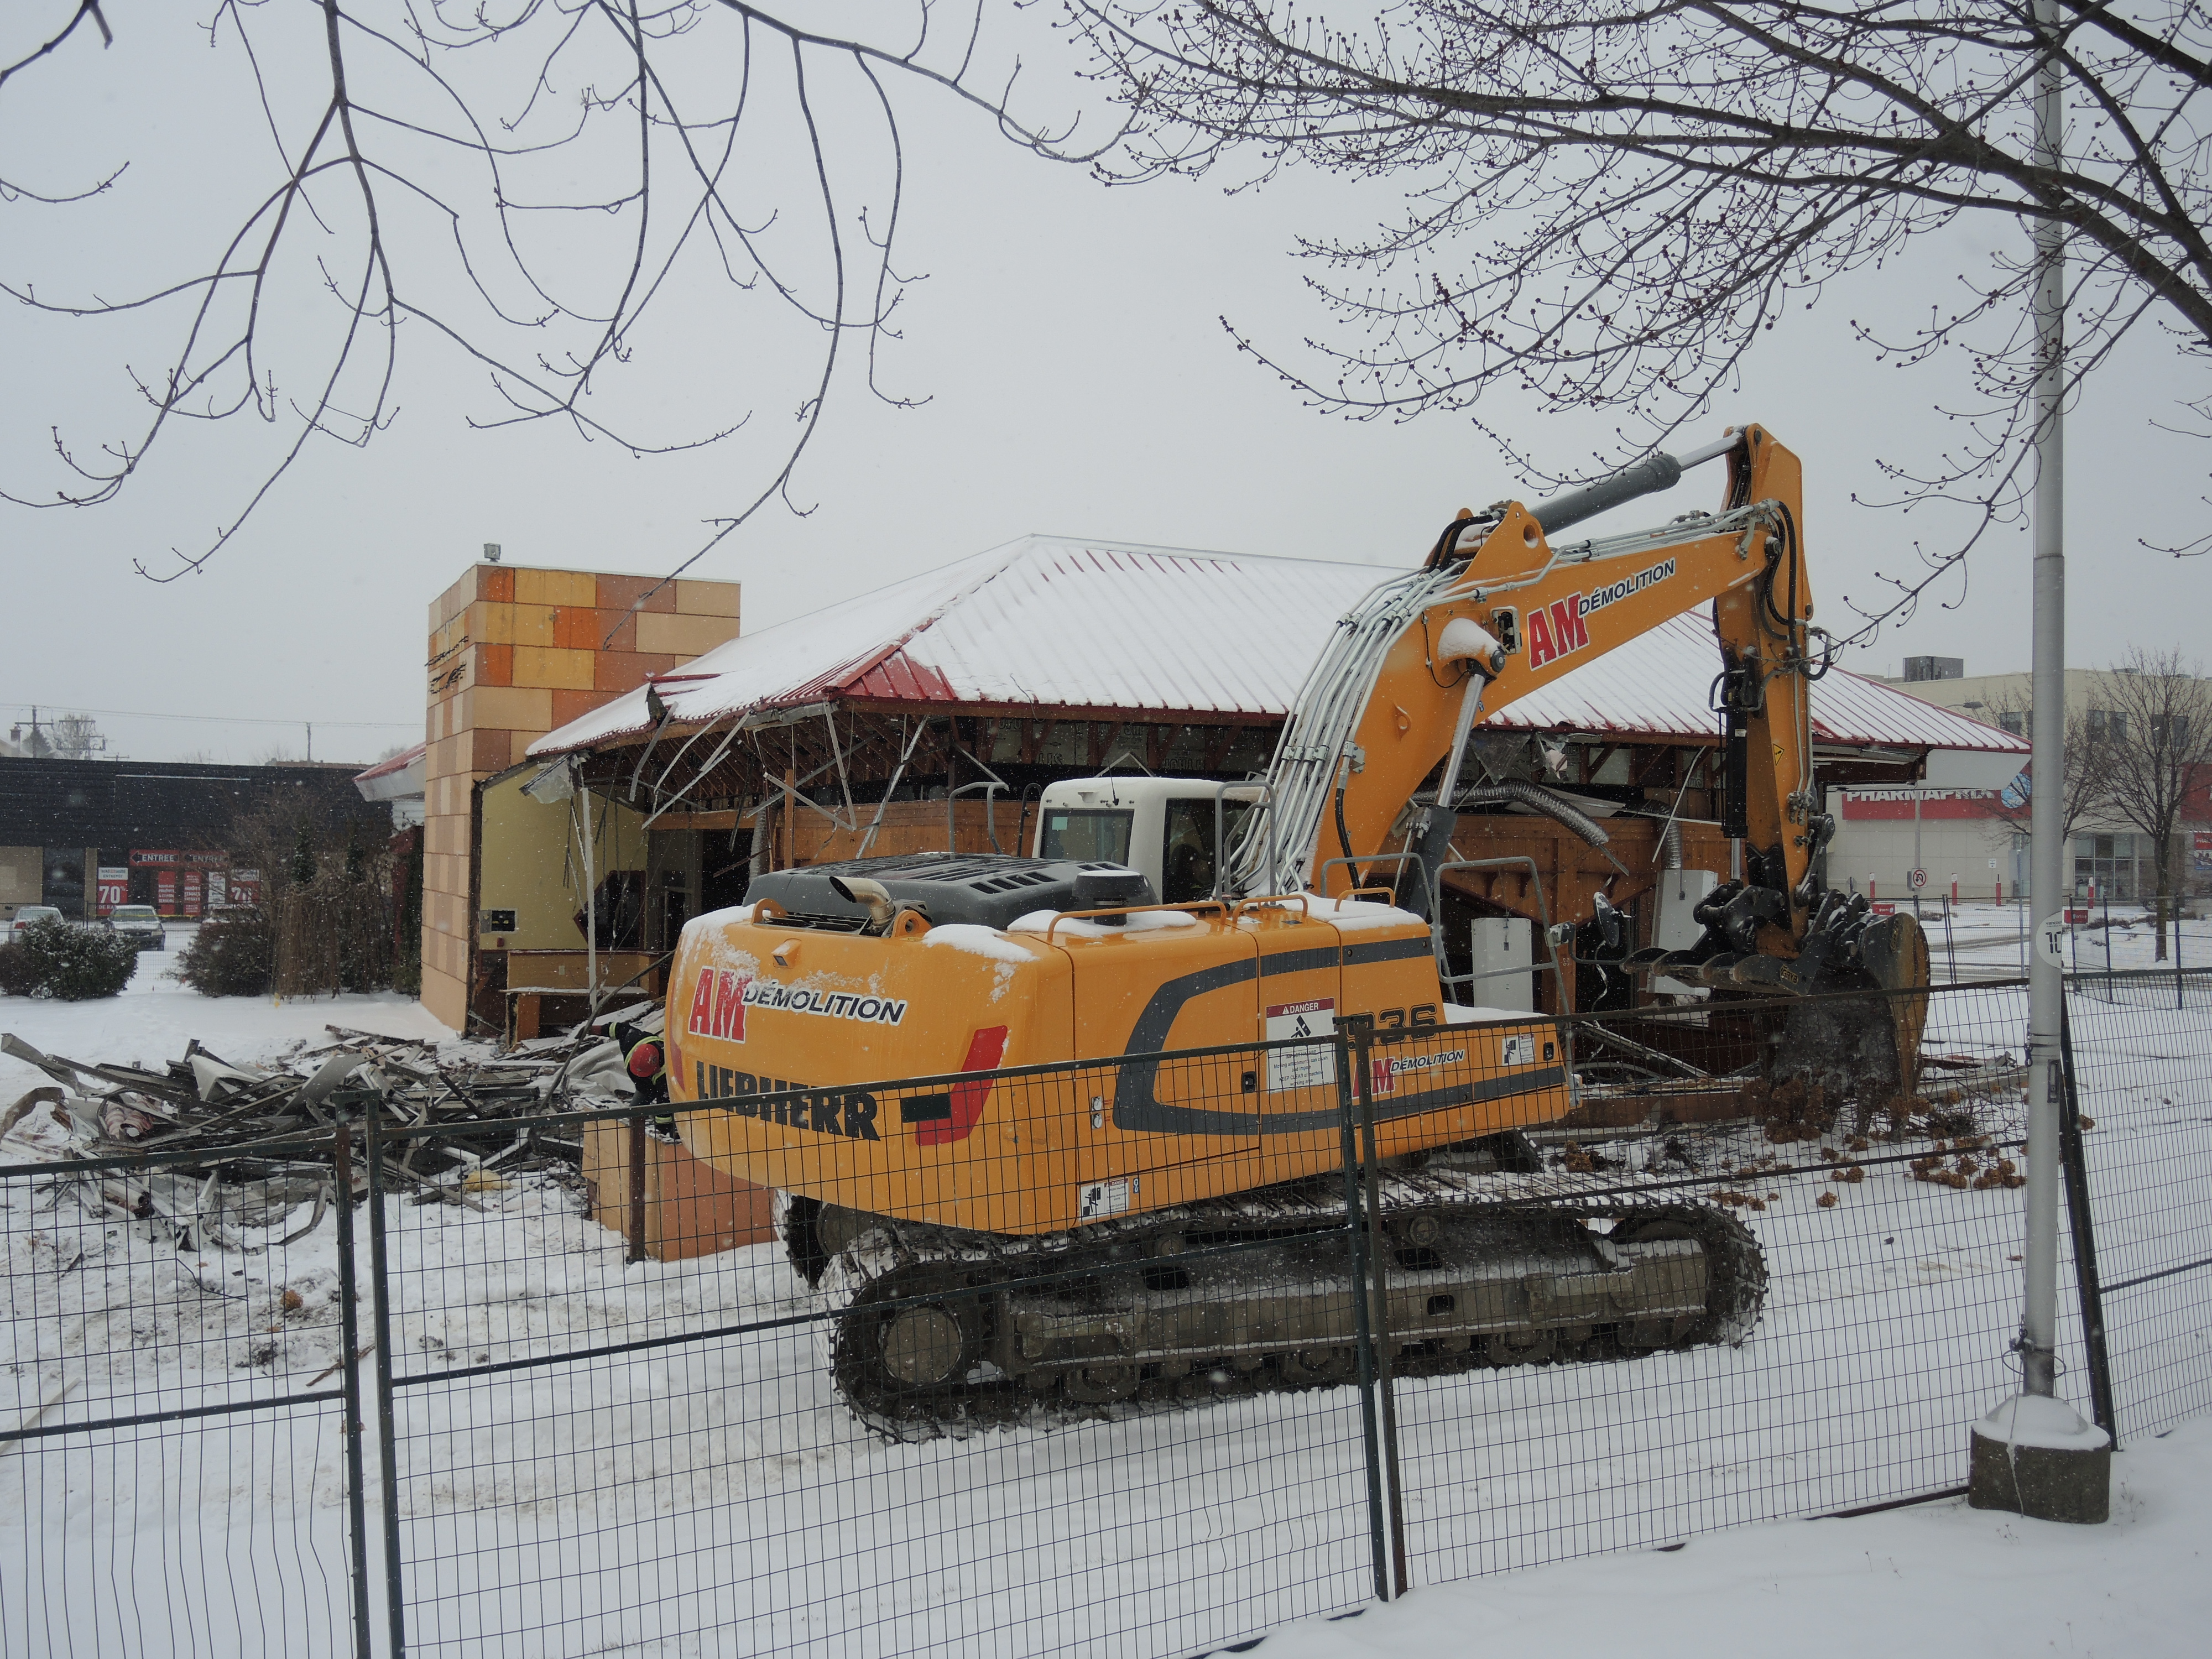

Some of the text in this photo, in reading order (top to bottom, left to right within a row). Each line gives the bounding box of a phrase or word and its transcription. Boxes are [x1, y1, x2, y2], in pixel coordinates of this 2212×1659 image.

[1527, 559, 1674, 671] AM DÉMOLITION
[689, 968, 905, 1042] AM DÉMOLITION
[1290, 1002, 1319, 1014] DANGER
[1391, 1050, 1465, 1072] DÉMOLITION
[696, 1060, 880, 1141] LIEBHERR
